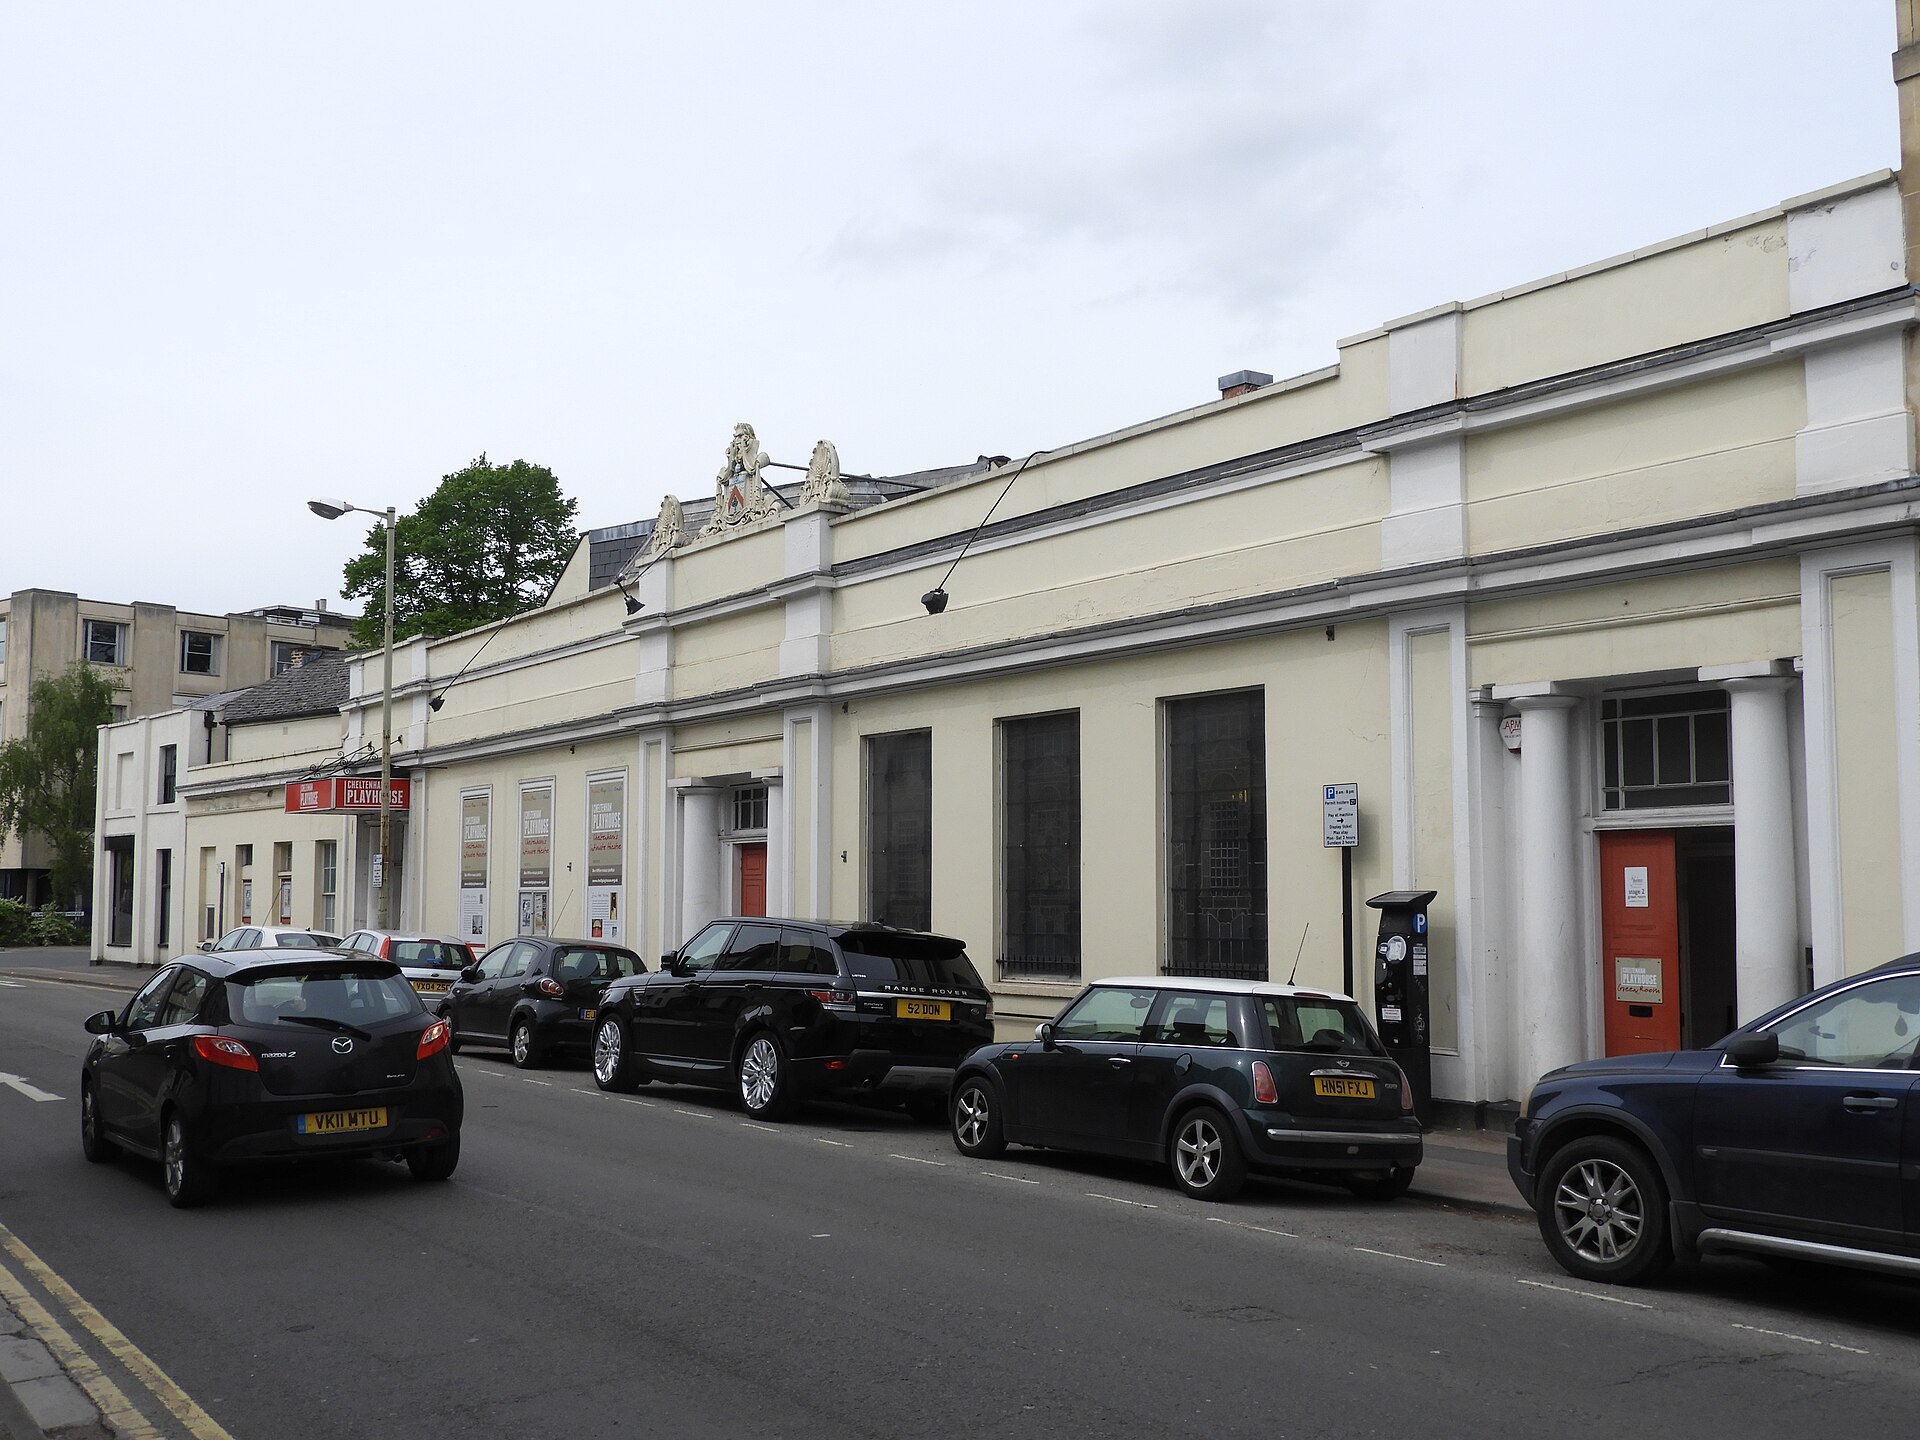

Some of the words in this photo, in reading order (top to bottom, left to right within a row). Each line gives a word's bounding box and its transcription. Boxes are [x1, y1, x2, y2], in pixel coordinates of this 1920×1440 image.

[347, 780, 382, 789] CHELTENHA
[1623, 973, 1657, 984] PLAYHOUSE
[923, 1004, 940, 1015] DON
[1321, 1080, 1345, 1094] HN51
[1348, 1082, 1368, 1095] FXJ
[315, 1112, 344, 1130] VK11
[349, 1110, 378, 1126] MTU
